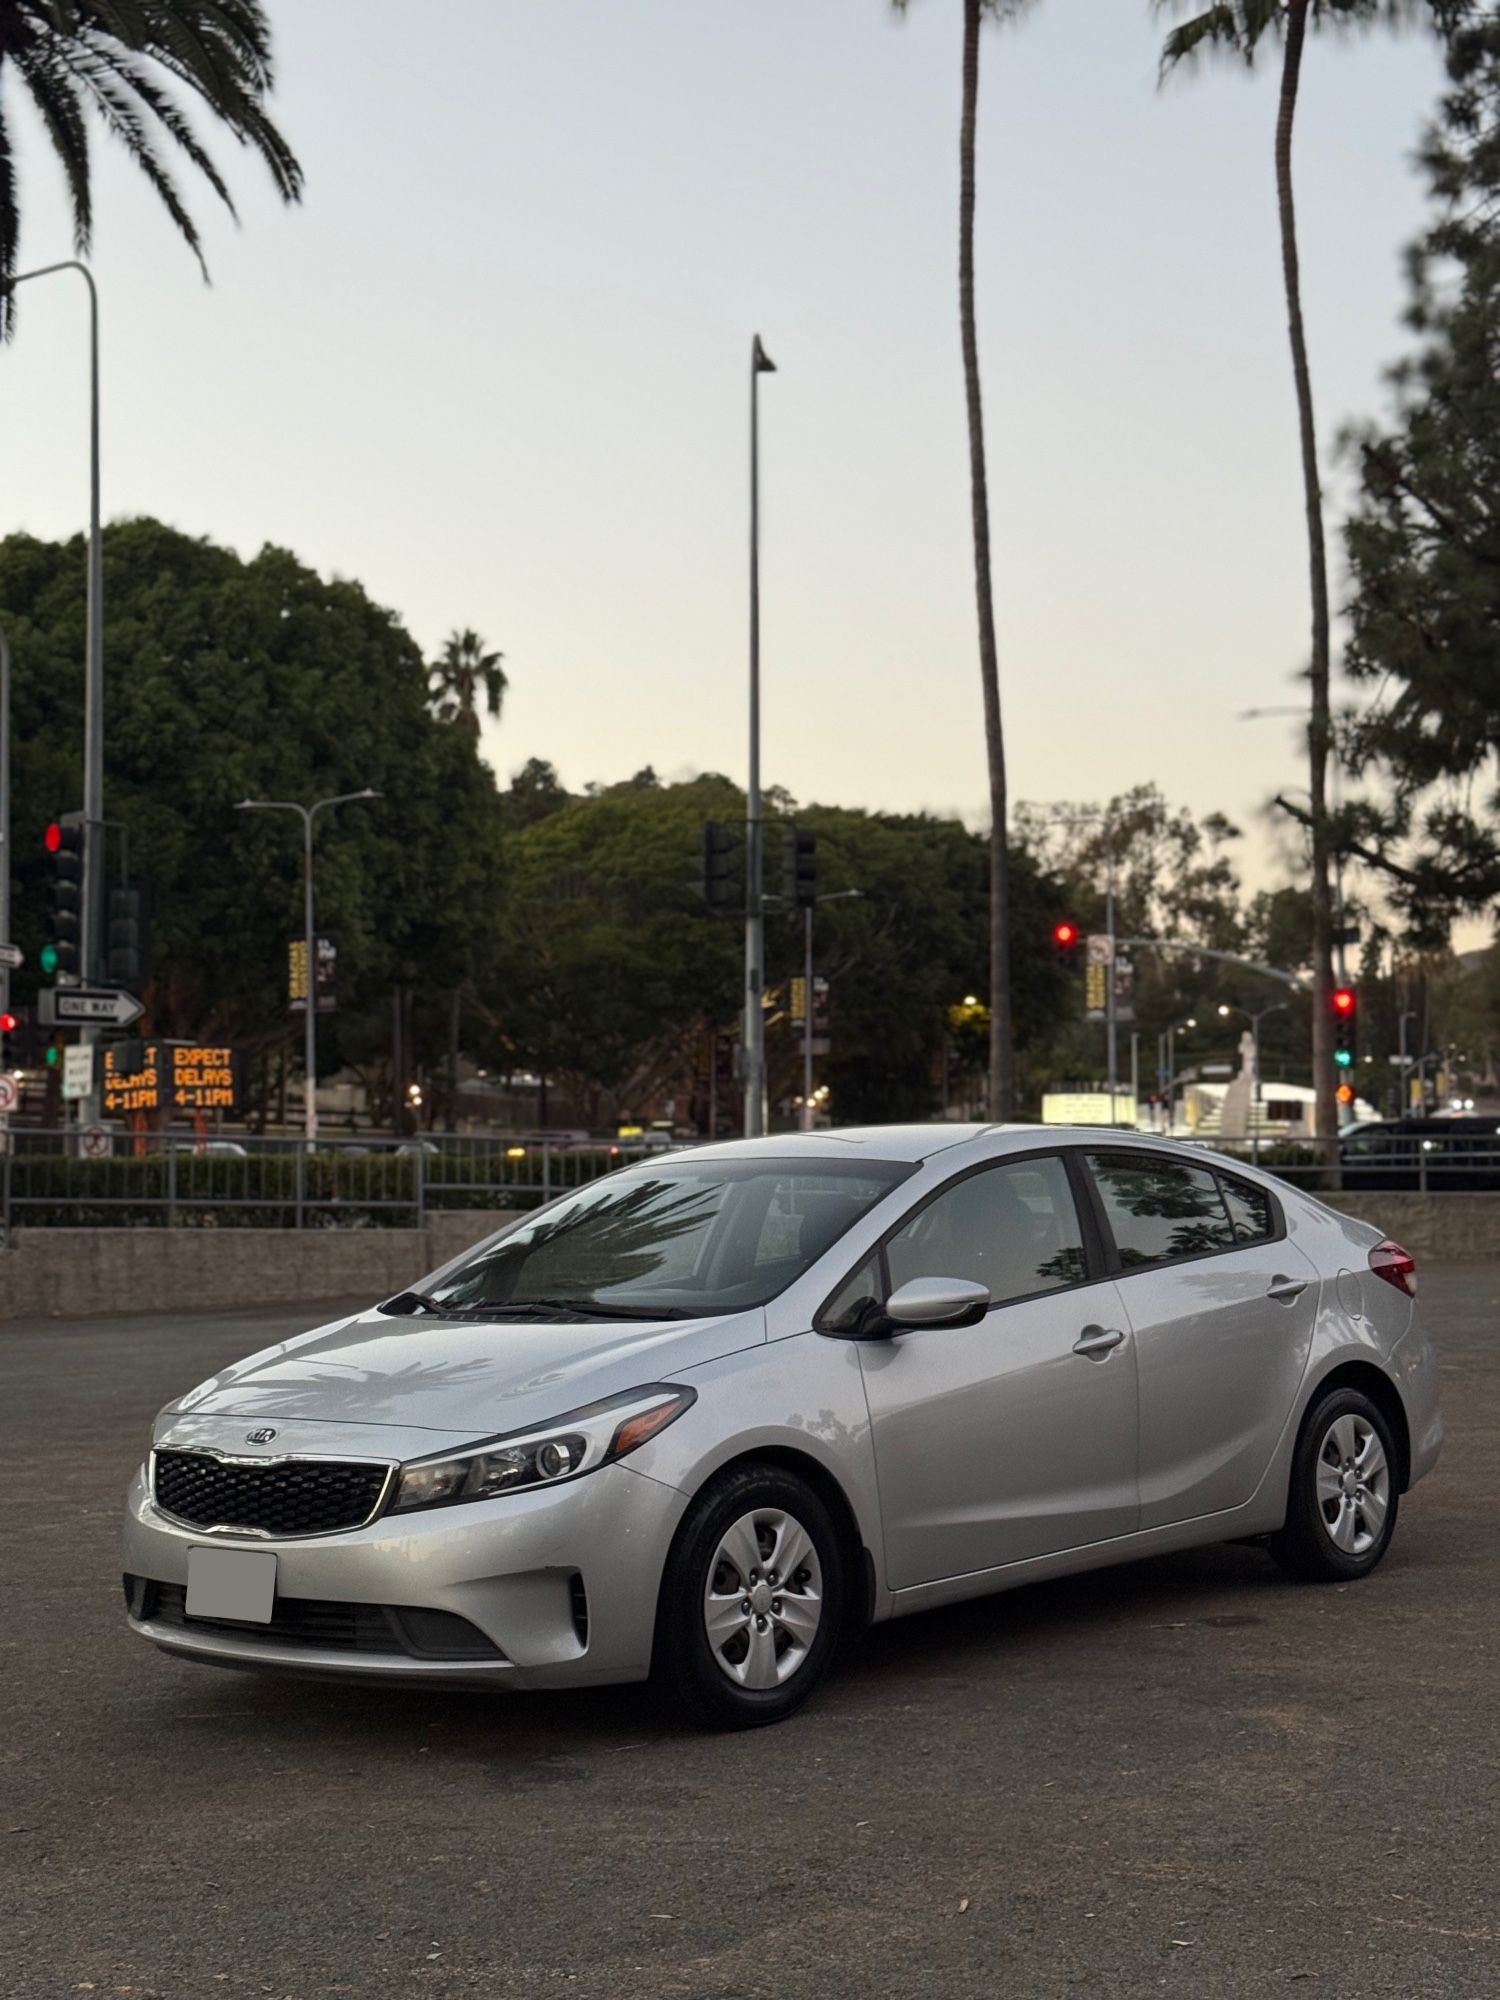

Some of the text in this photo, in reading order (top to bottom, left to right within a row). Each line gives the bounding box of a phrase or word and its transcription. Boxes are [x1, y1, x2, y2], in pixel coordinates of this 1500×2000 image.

[62, 1000, 115, 1014] ONE WAY
[174, 1048, 232, 1066] EXPECT
[174, 1068, 233, 1086] DELAYS
[105, 1089, 157, 1110] 4-11PM
[175, 1088, 234, 1106] 4-11PM
